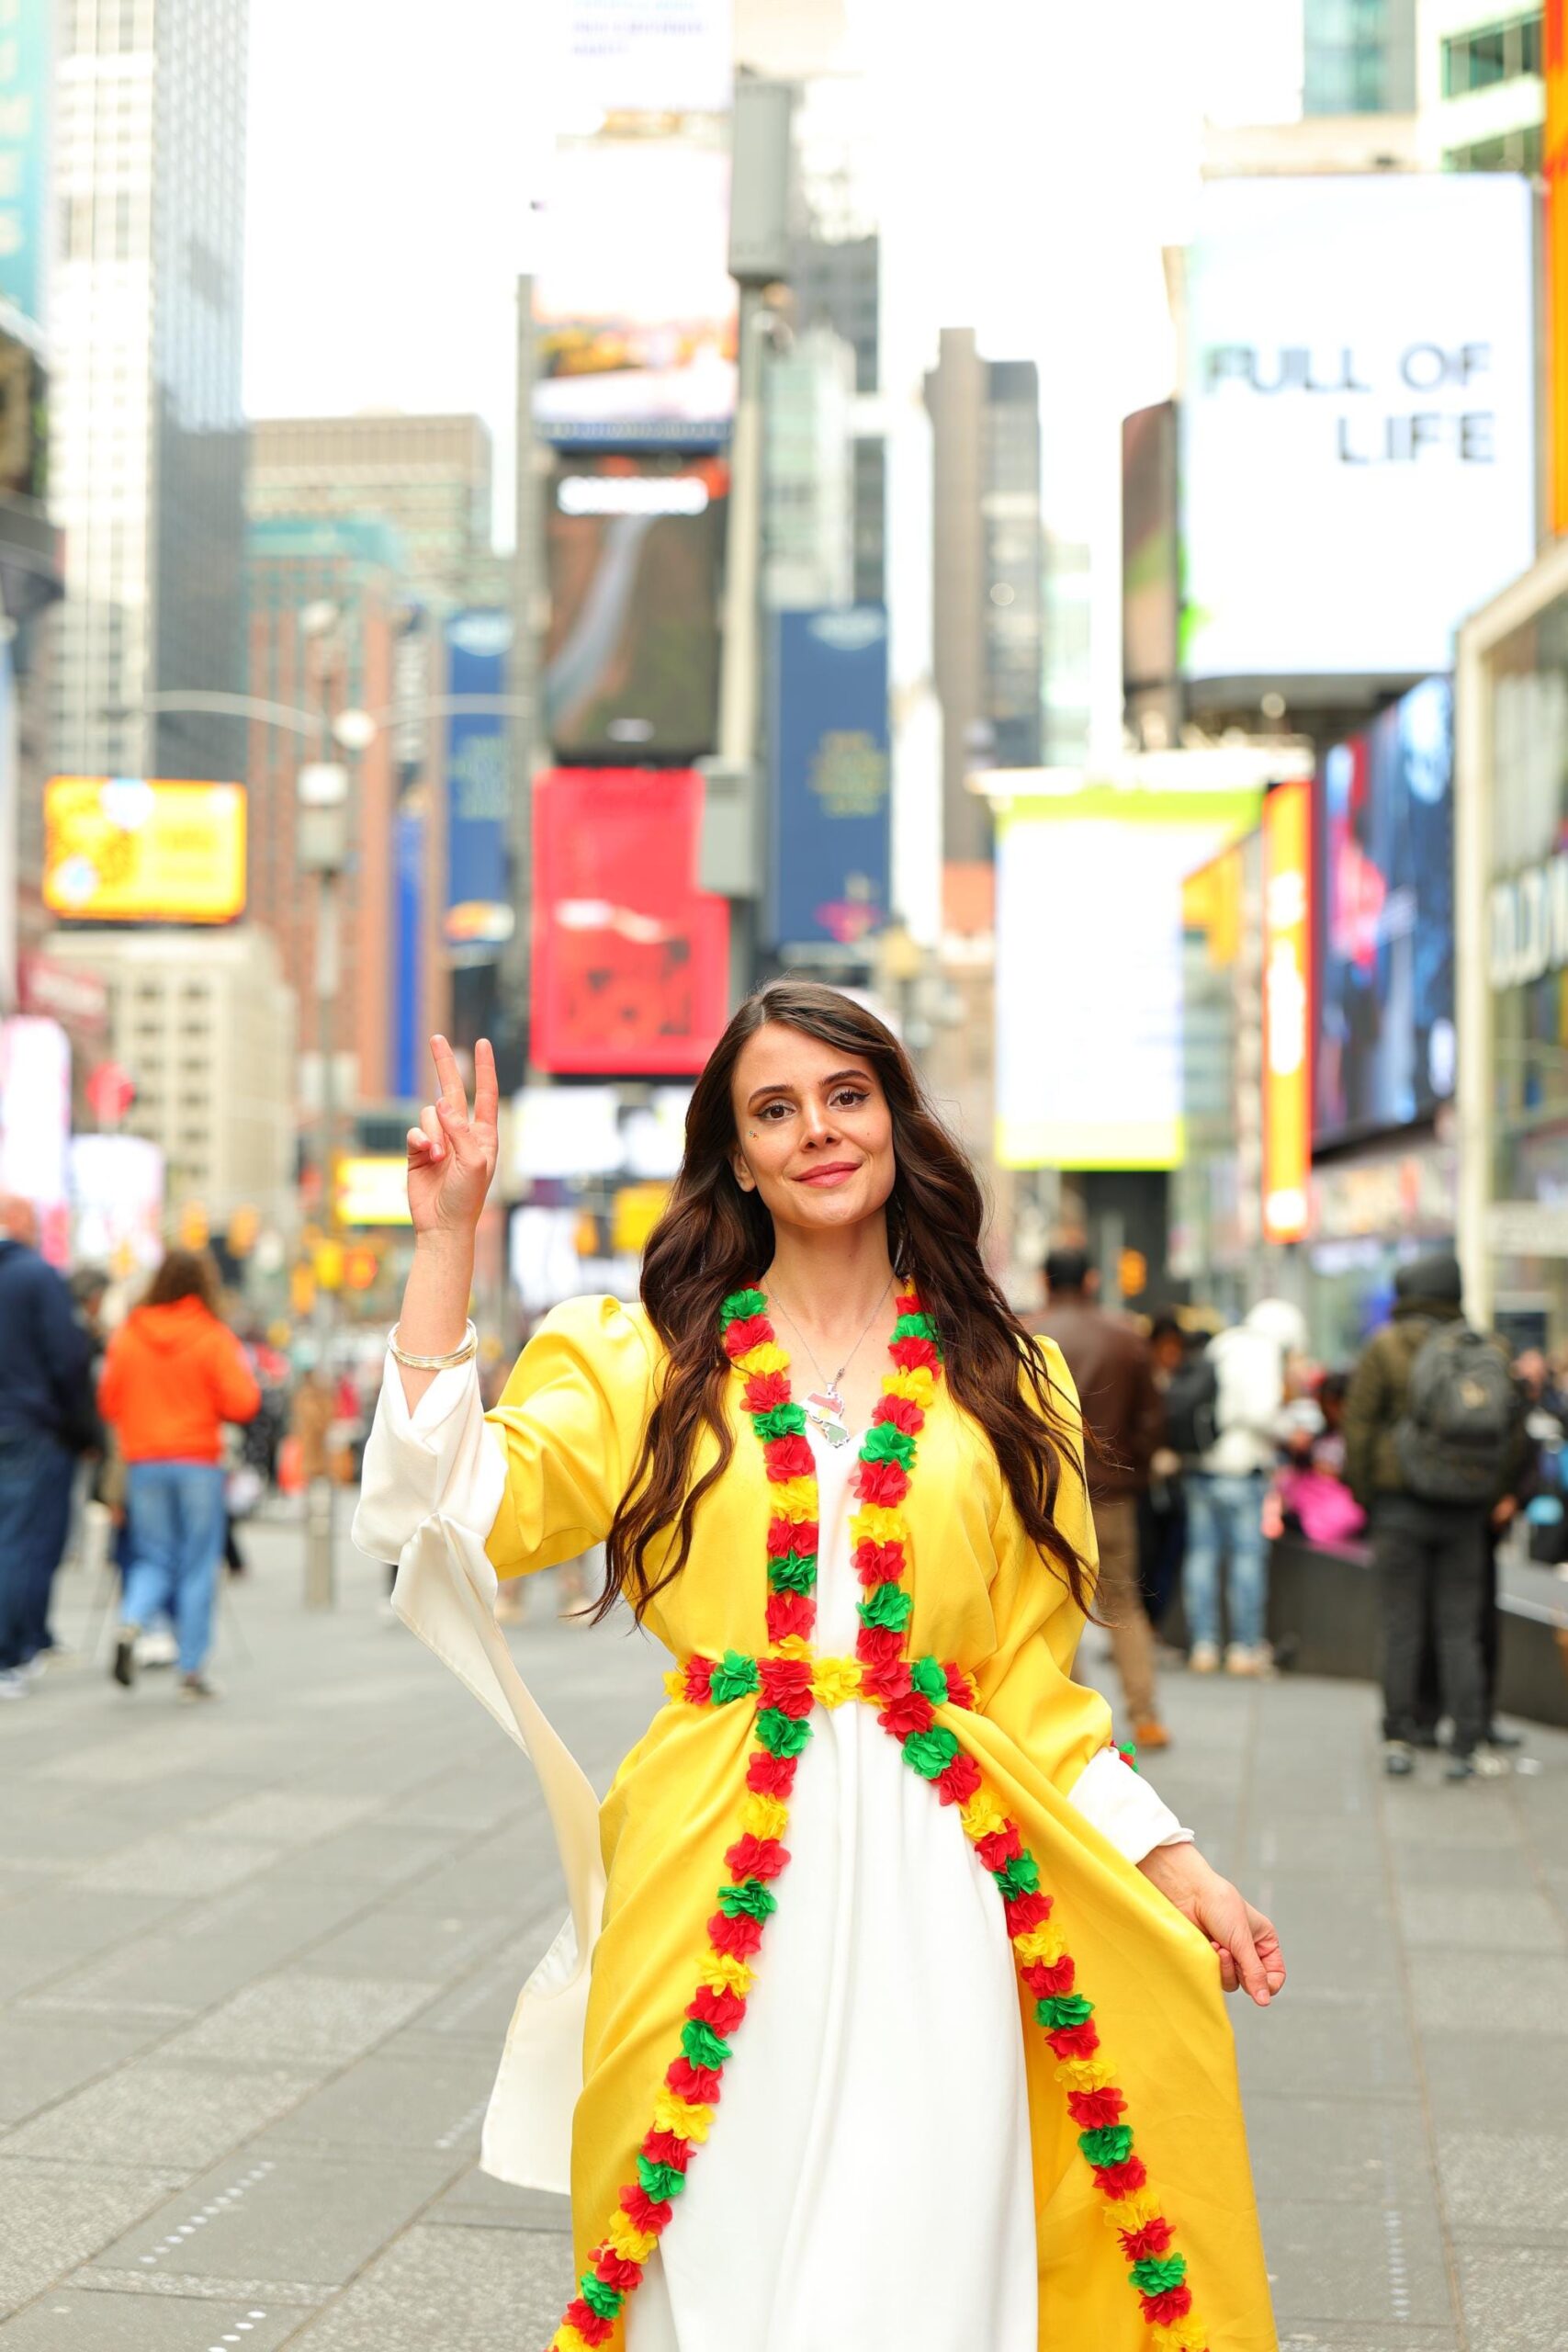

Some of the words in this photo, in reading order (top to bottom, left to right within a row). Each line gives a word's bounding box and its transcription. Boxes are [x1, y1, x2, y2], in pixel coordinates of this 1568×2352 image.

[1203, 344, 1371, 395] FULL
[1400, 342, 1490, 393] OF
[1337, 410, 1495, 466] LIFE
